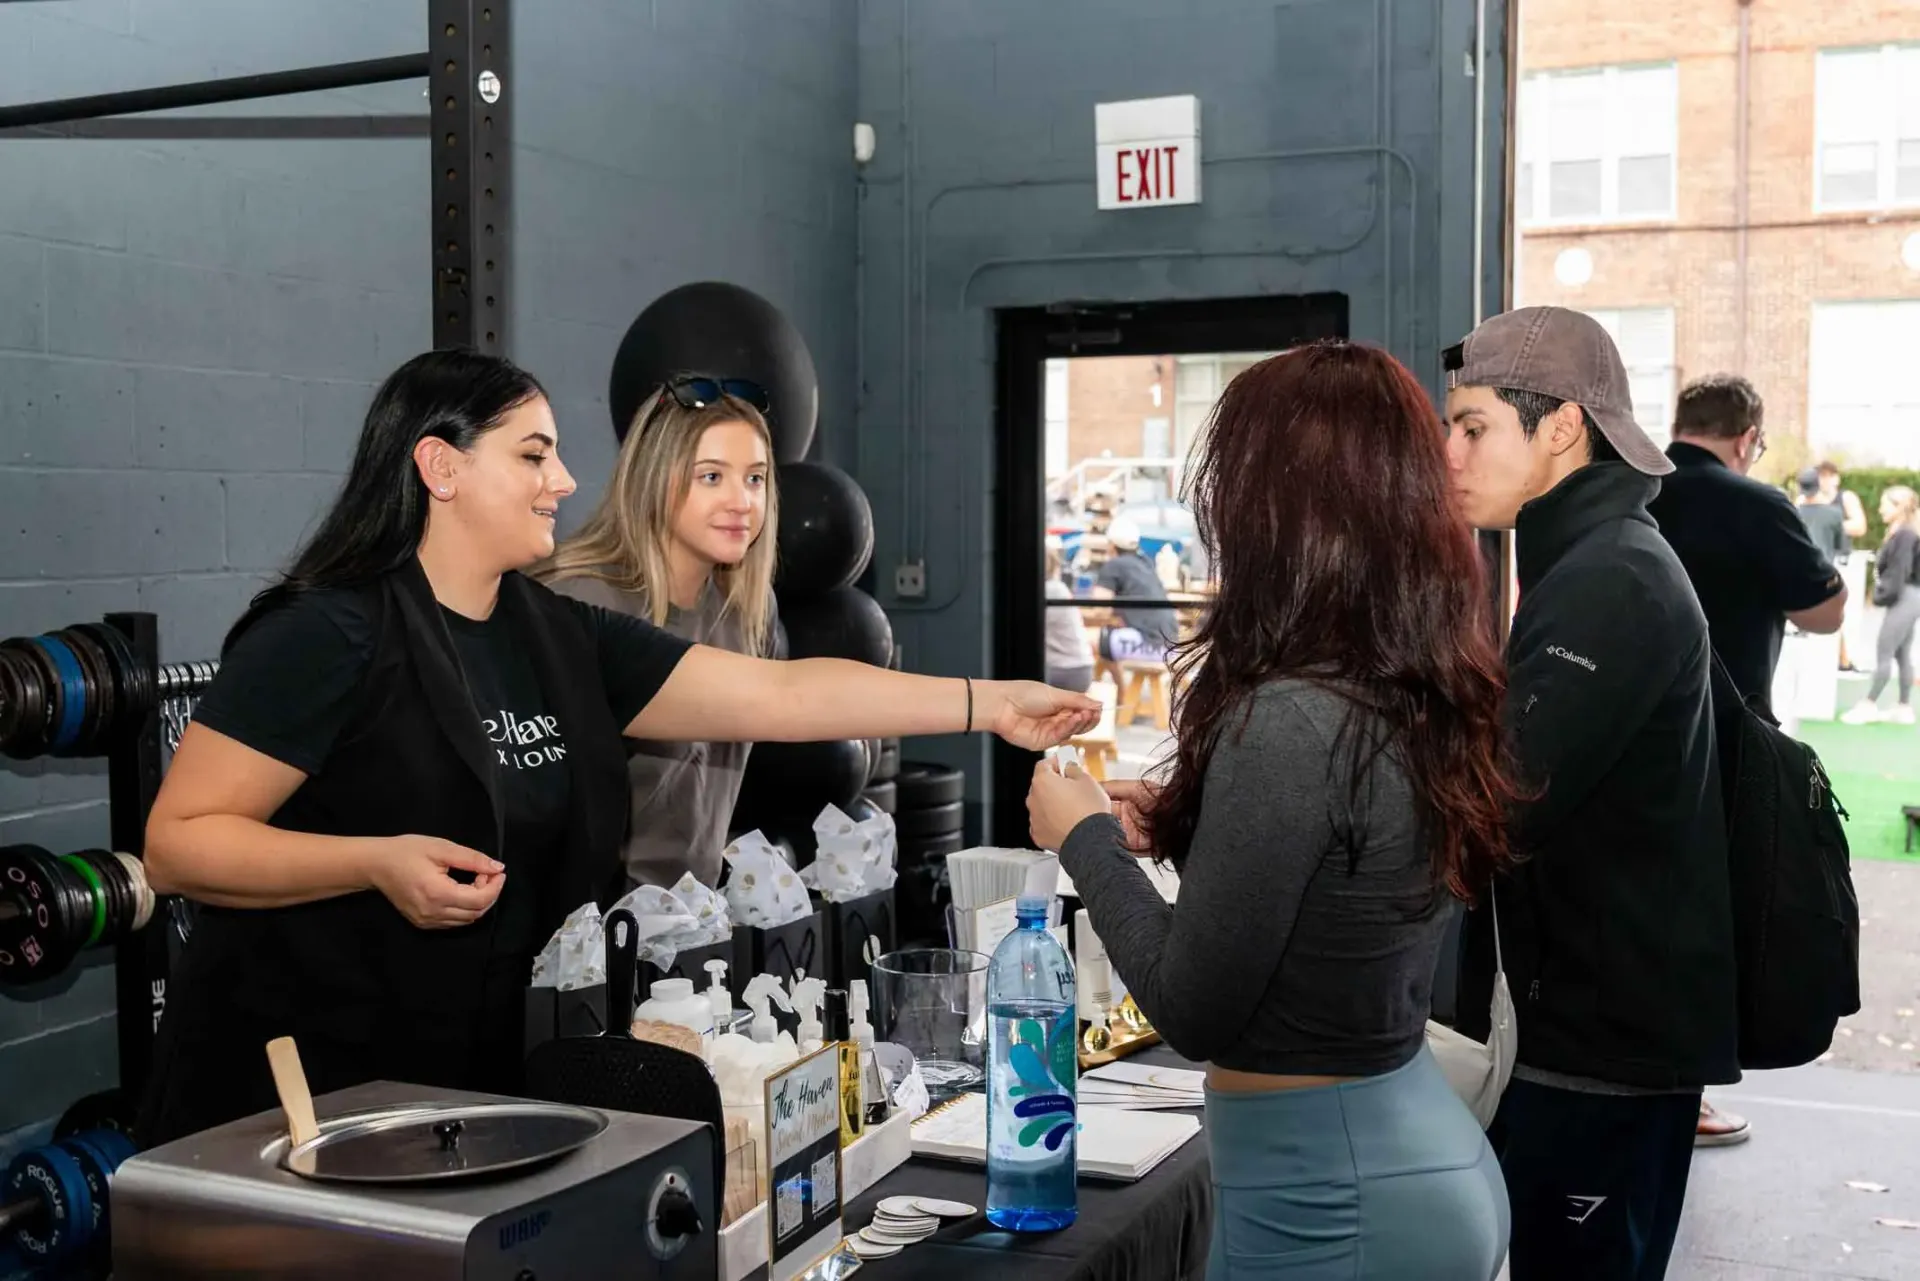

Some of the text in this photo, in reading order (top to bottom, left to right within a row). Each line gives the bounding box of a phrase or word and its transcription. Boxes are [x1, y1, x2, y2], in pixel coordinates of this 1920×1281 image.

[1116, 146, 1179, 202] EXIT
[1555, 646, 1597, 672] Columbia
[490, 709, 561, 745] Have
[513, 743, 567, 769] LOUN
[771, 1076, 835, 1130] The Haven
[27, 1163, 66, 1220] ROGUE
